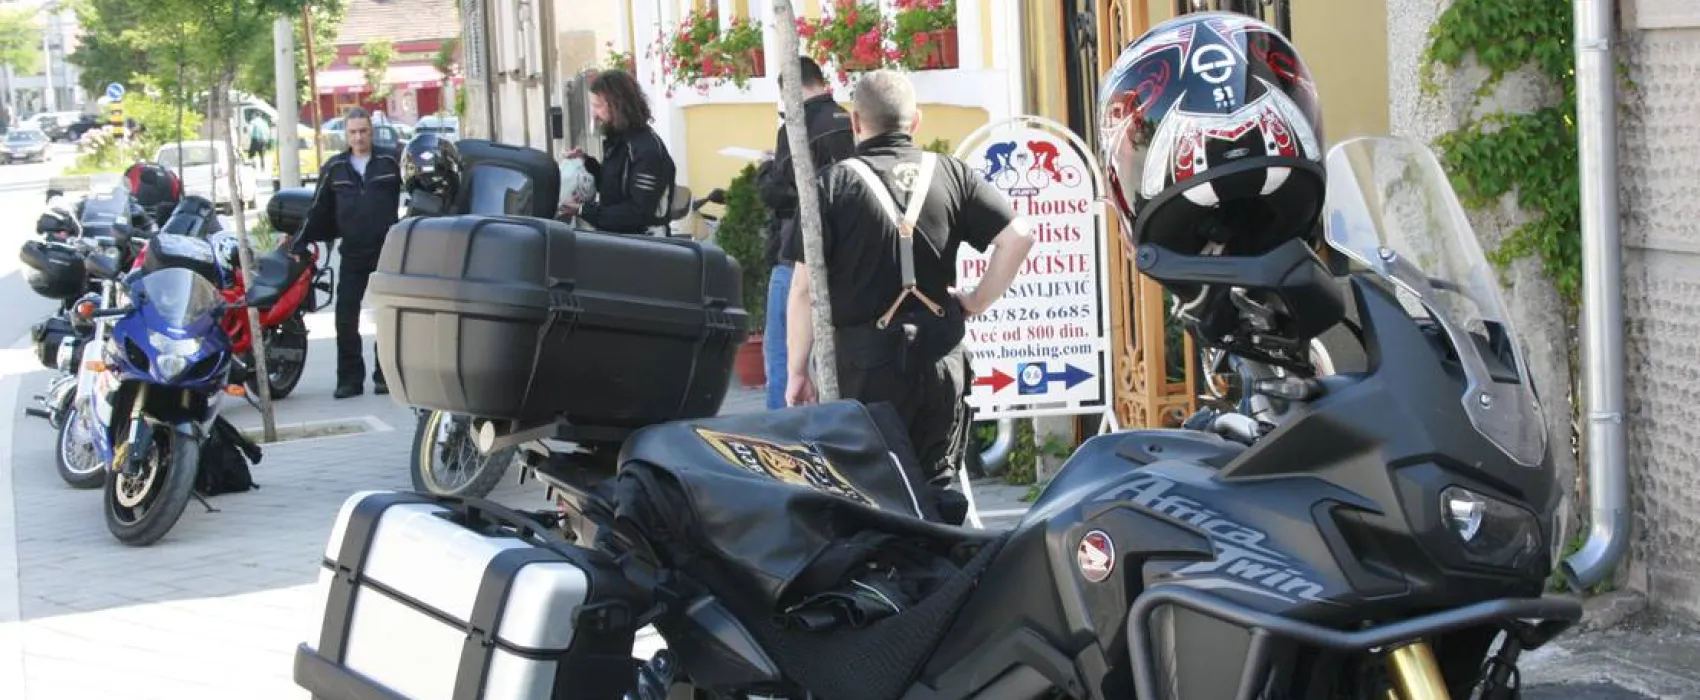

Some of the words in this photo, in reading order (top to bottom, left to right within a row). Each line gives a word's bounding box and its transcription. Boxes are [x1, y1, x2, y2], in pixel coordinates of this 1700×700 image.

[1027, 195, 1089, 216] house
[1032, 221, 1081, 243] lists
[961, 250, 1090, 279] PROĆIŠTE
[1046, 304, 1091, 319] 6685
[1002, 326, 1021, 342] od
[1026, 324, 1055, 340] 800
[1059, 322, 1089, 339] din.
[1092, 475, 1268, 549] Africa
[1172, 540, 1326, 602] Twin
